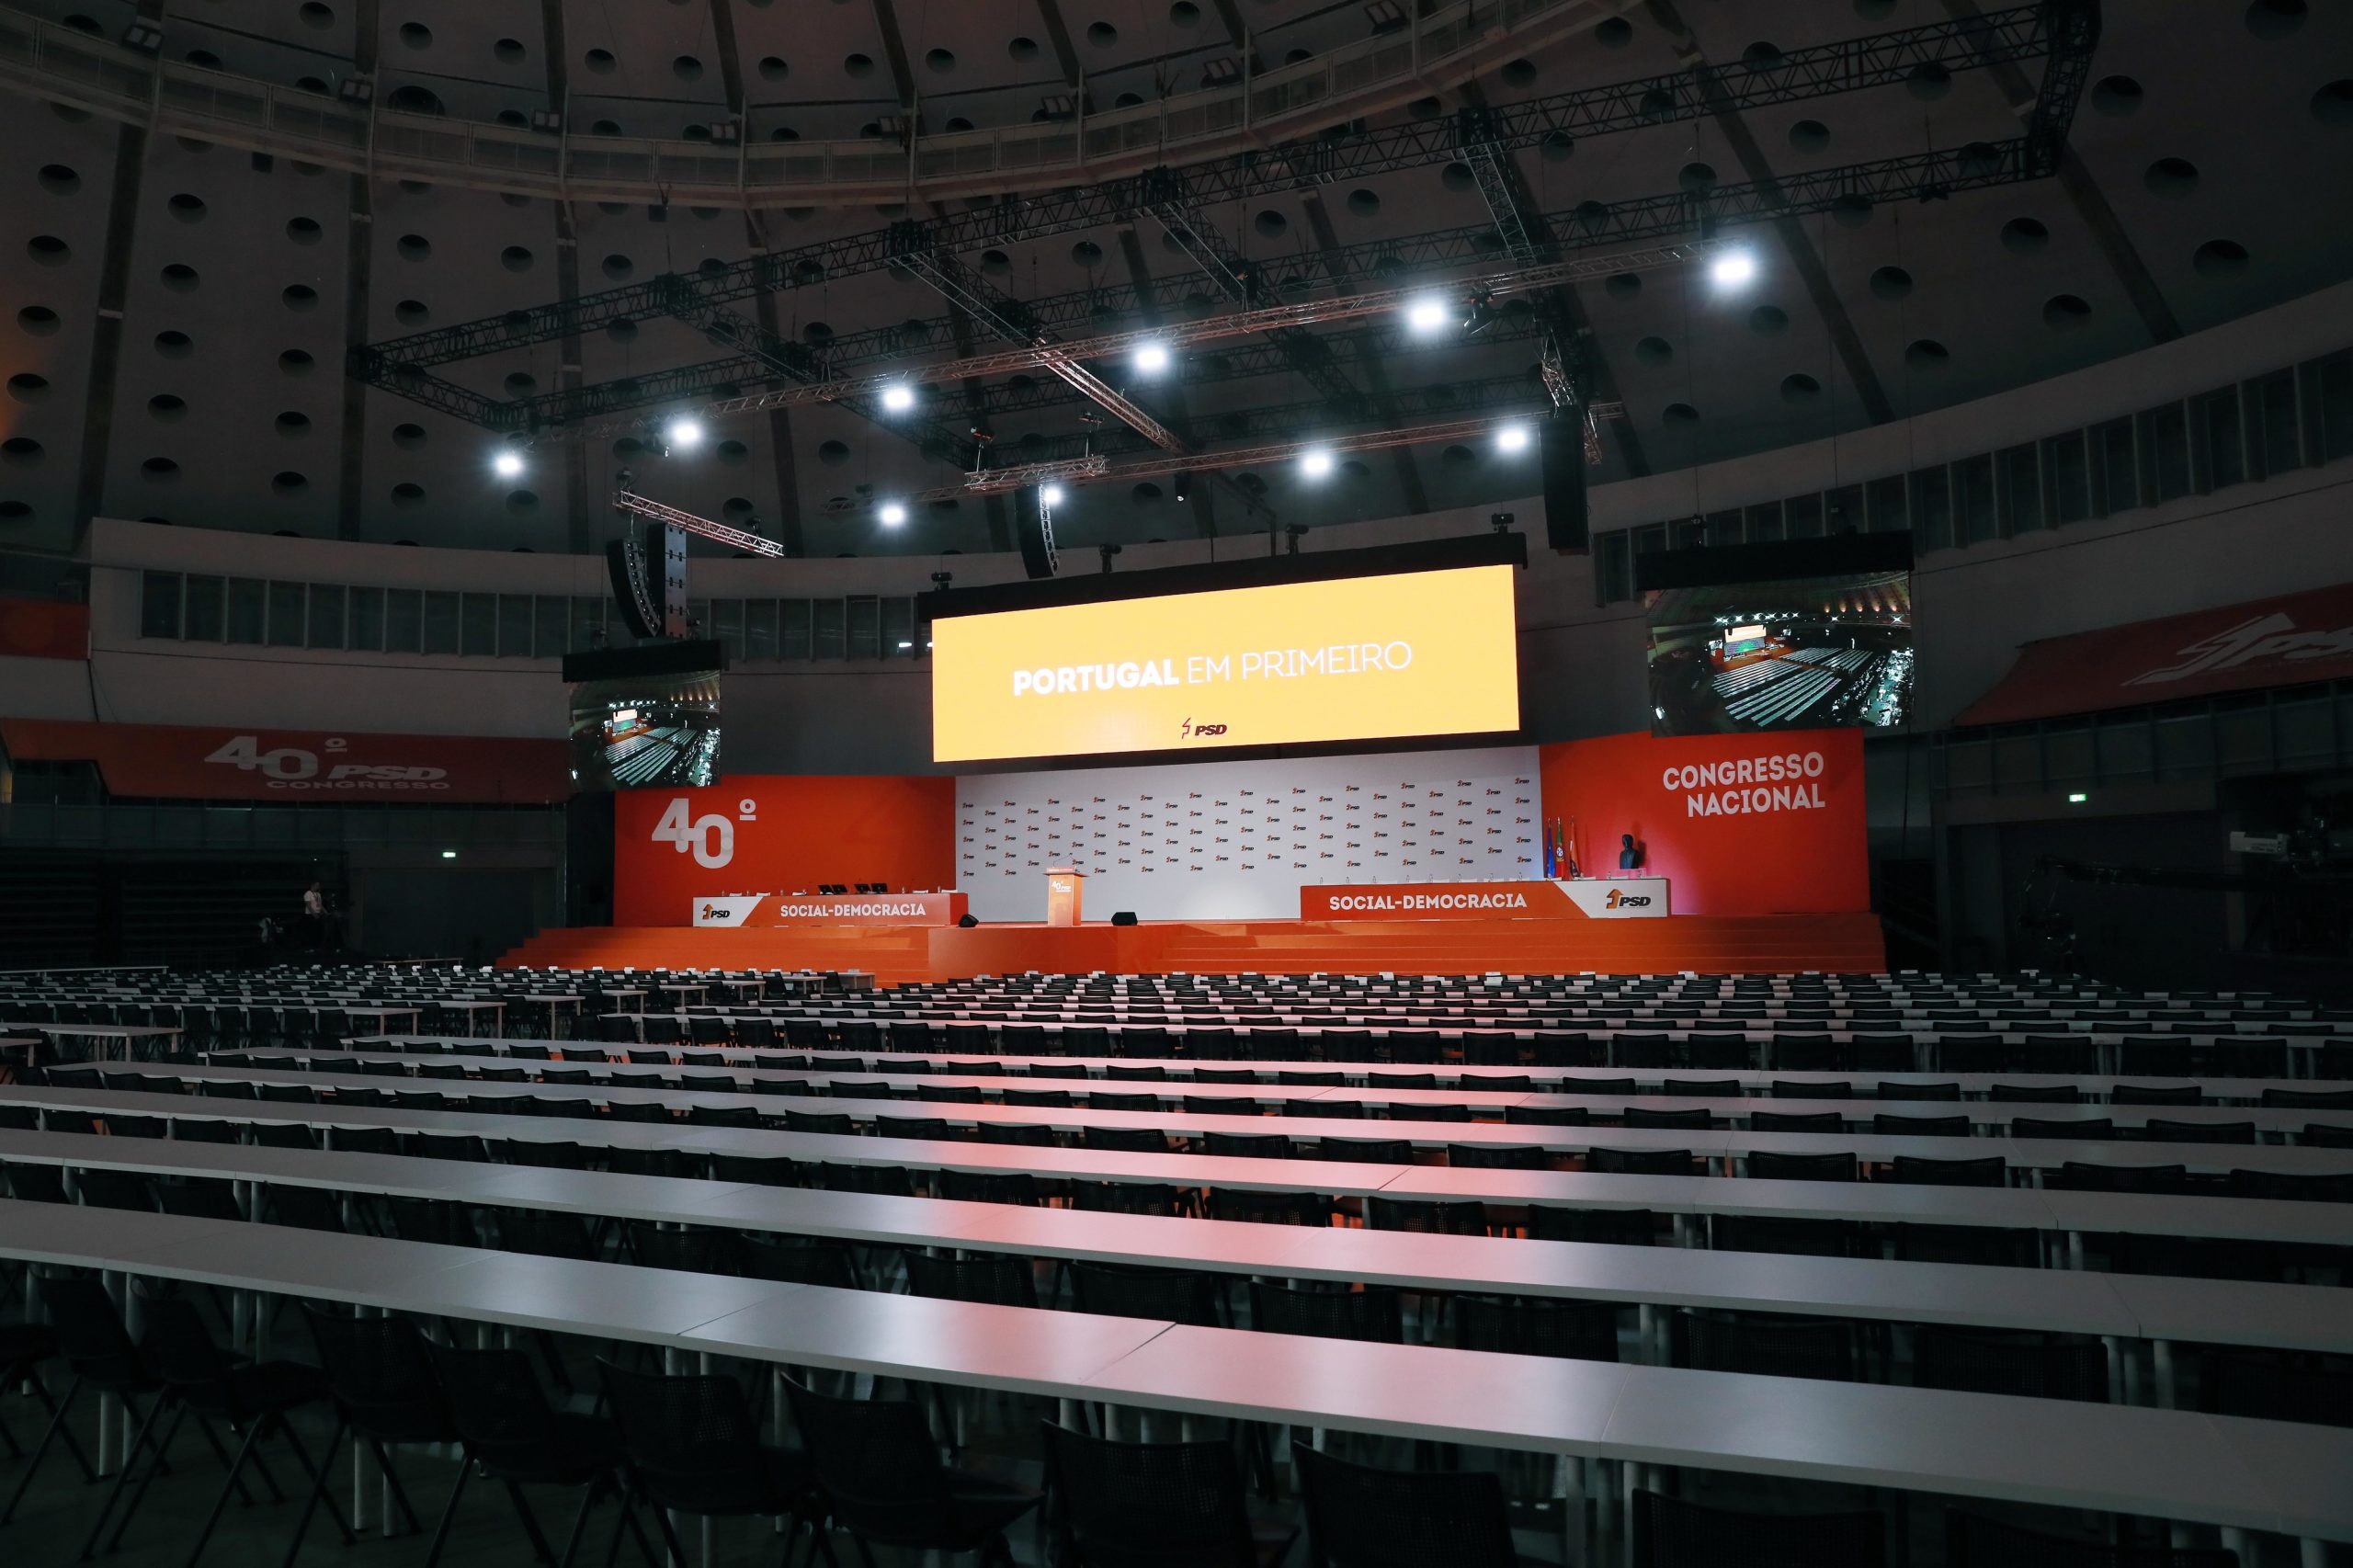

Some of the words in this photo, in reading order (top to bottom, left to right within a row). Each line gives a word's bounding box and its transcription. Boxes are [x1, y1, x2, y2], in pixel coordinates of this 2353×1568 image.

[1014, 659, 1180, 697] PORTUGAL
[1188, 655, 1232, 685] EM
[1242, 641, 1413, 679] PRIMEIRO
[1195, 724, 1228, 736] PSD
[327, 764, 448, 780] PSD
[1663, 752, 1824, 791] CONGRESSO
[267, 780, 451, 790] CONGRESSO
[1688, 783, 1826, 818] NACIONAL
[1329, 892, 1528, 911] SOCIAL-DEMOCRACIA
[1619, 896, 1652, 906] PSD
[710, 910, 731, 918] PSD
[780, 903, 926, 918] SOCIAL-DEMOCRACIA
